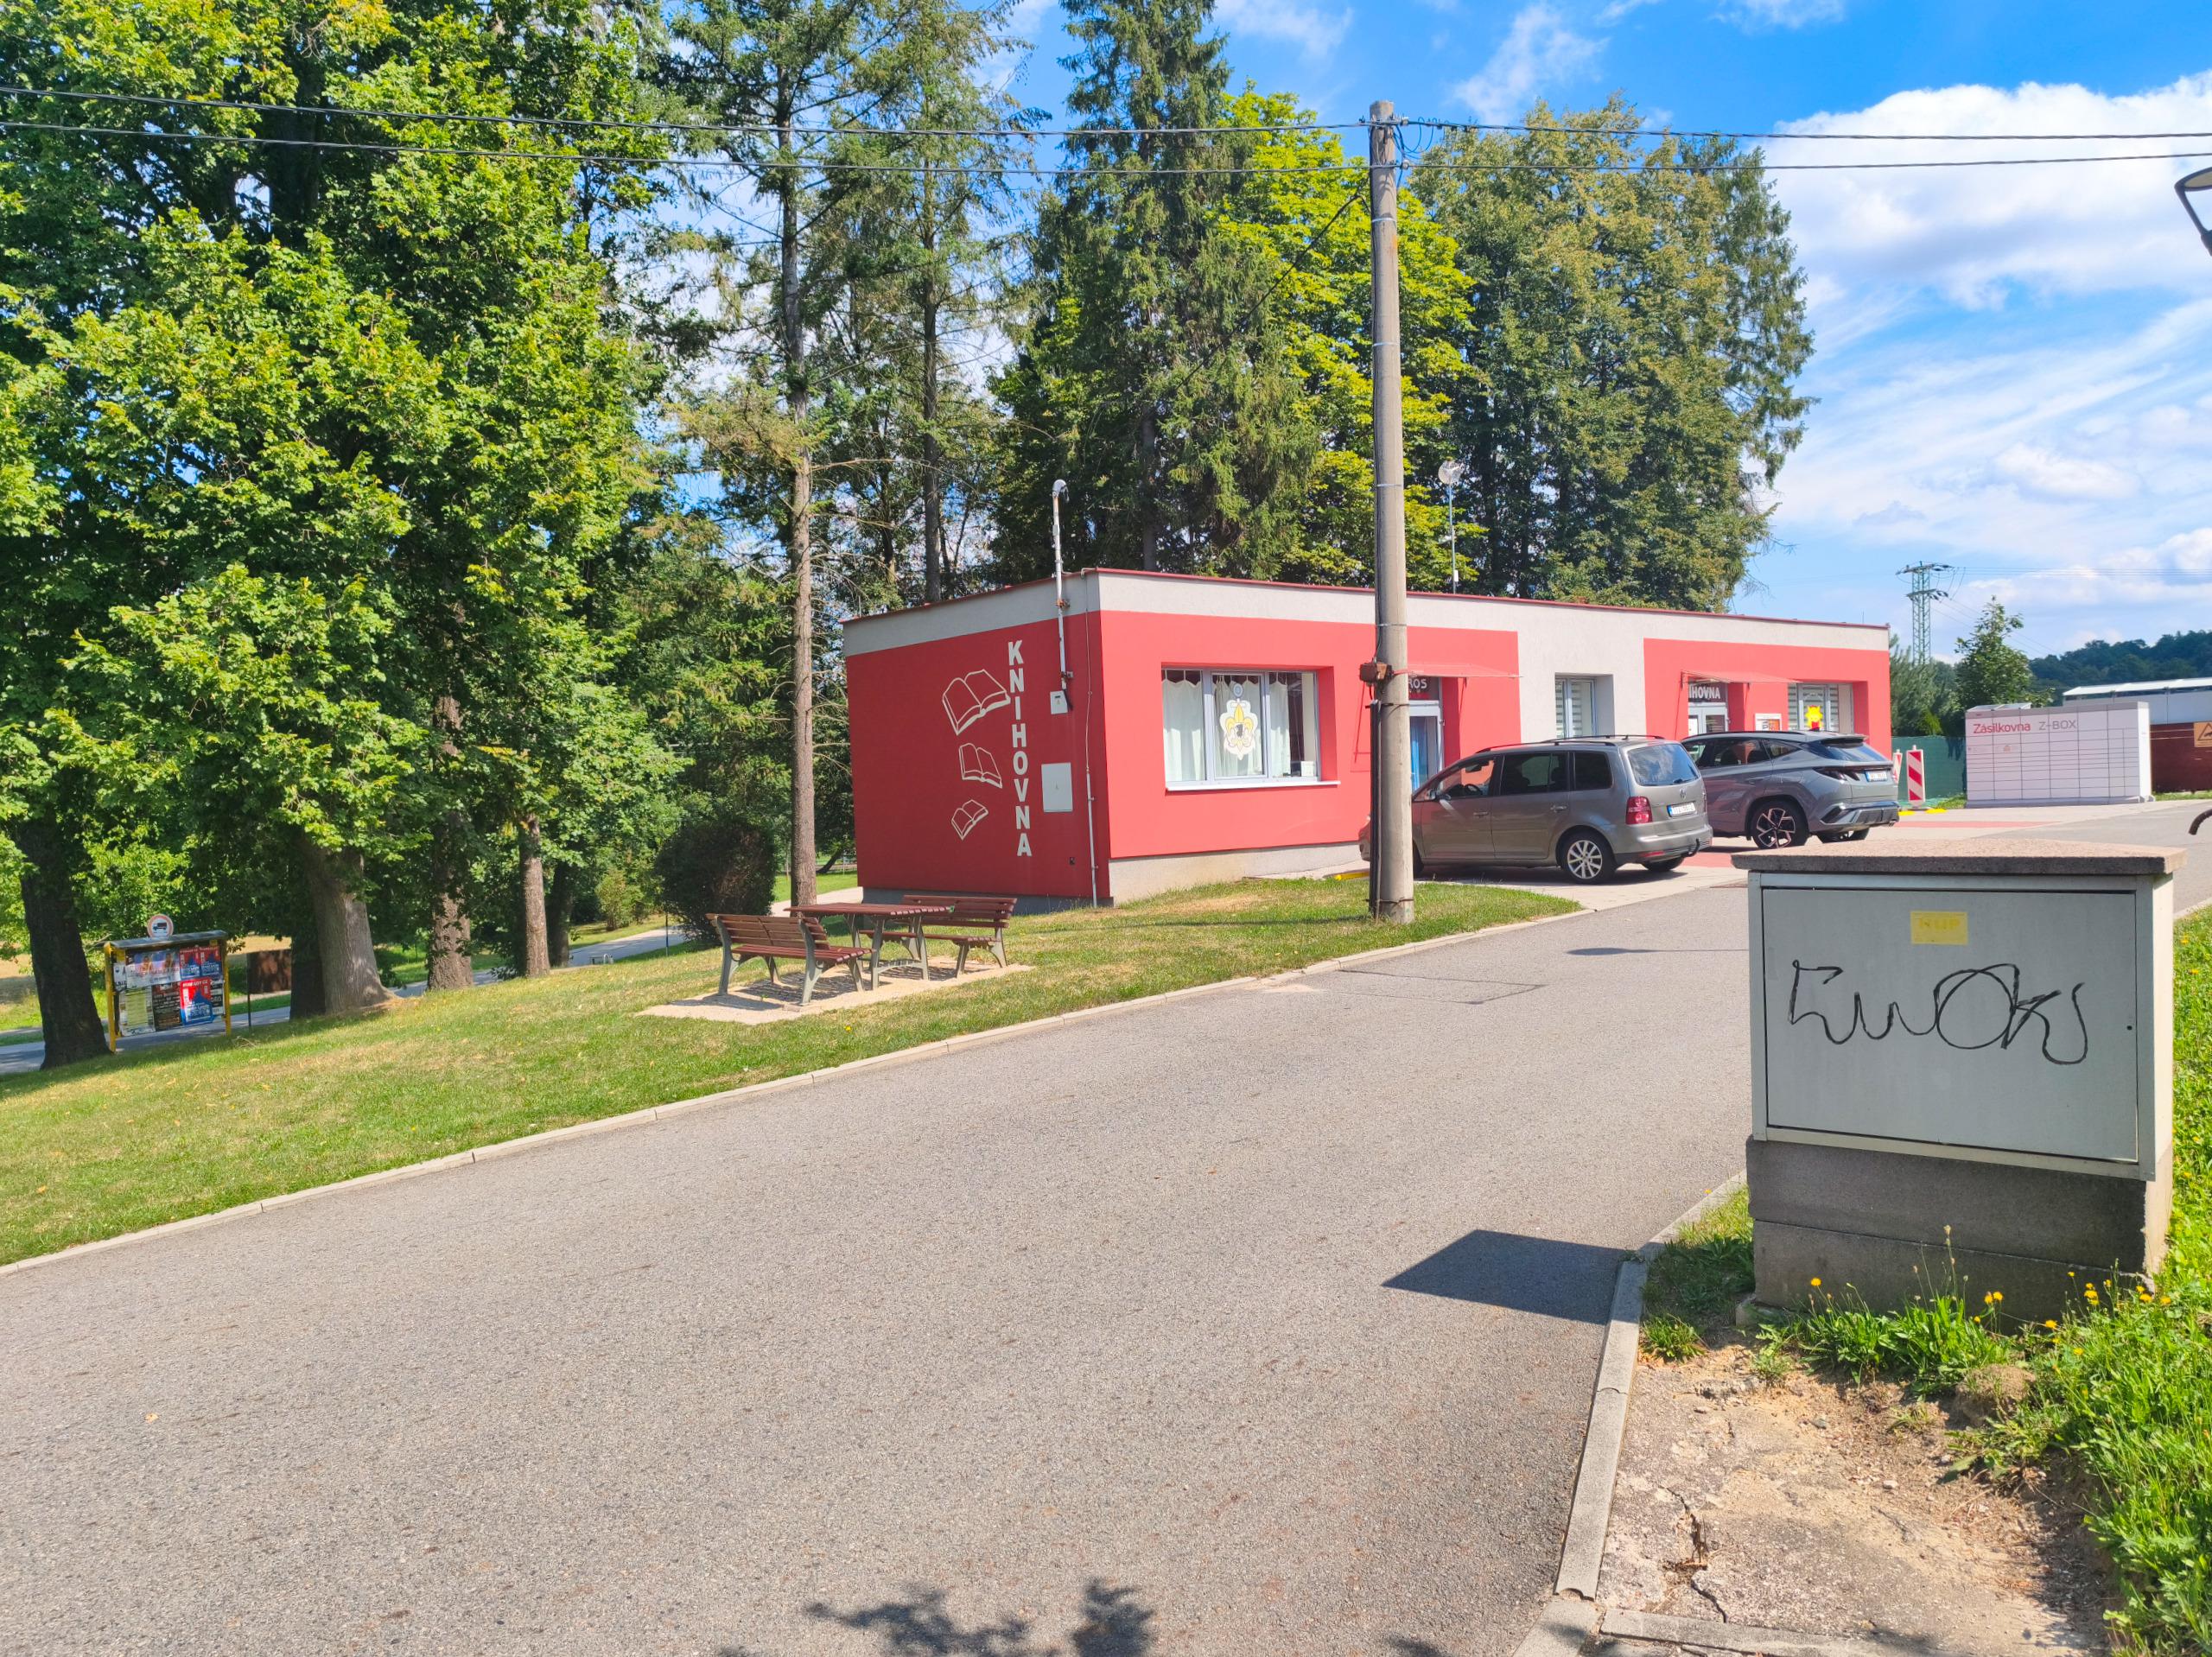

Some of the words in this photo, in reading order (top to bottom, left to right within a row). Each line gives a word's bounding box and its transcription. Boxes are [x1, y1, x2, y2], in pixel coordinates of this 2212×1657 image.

[1007, 640, 1033, 857] KNIHOVNA
[1973, 723, 2031, 733] Zásilkovna
[2039, 720, 2076, 731] Z-BOX
